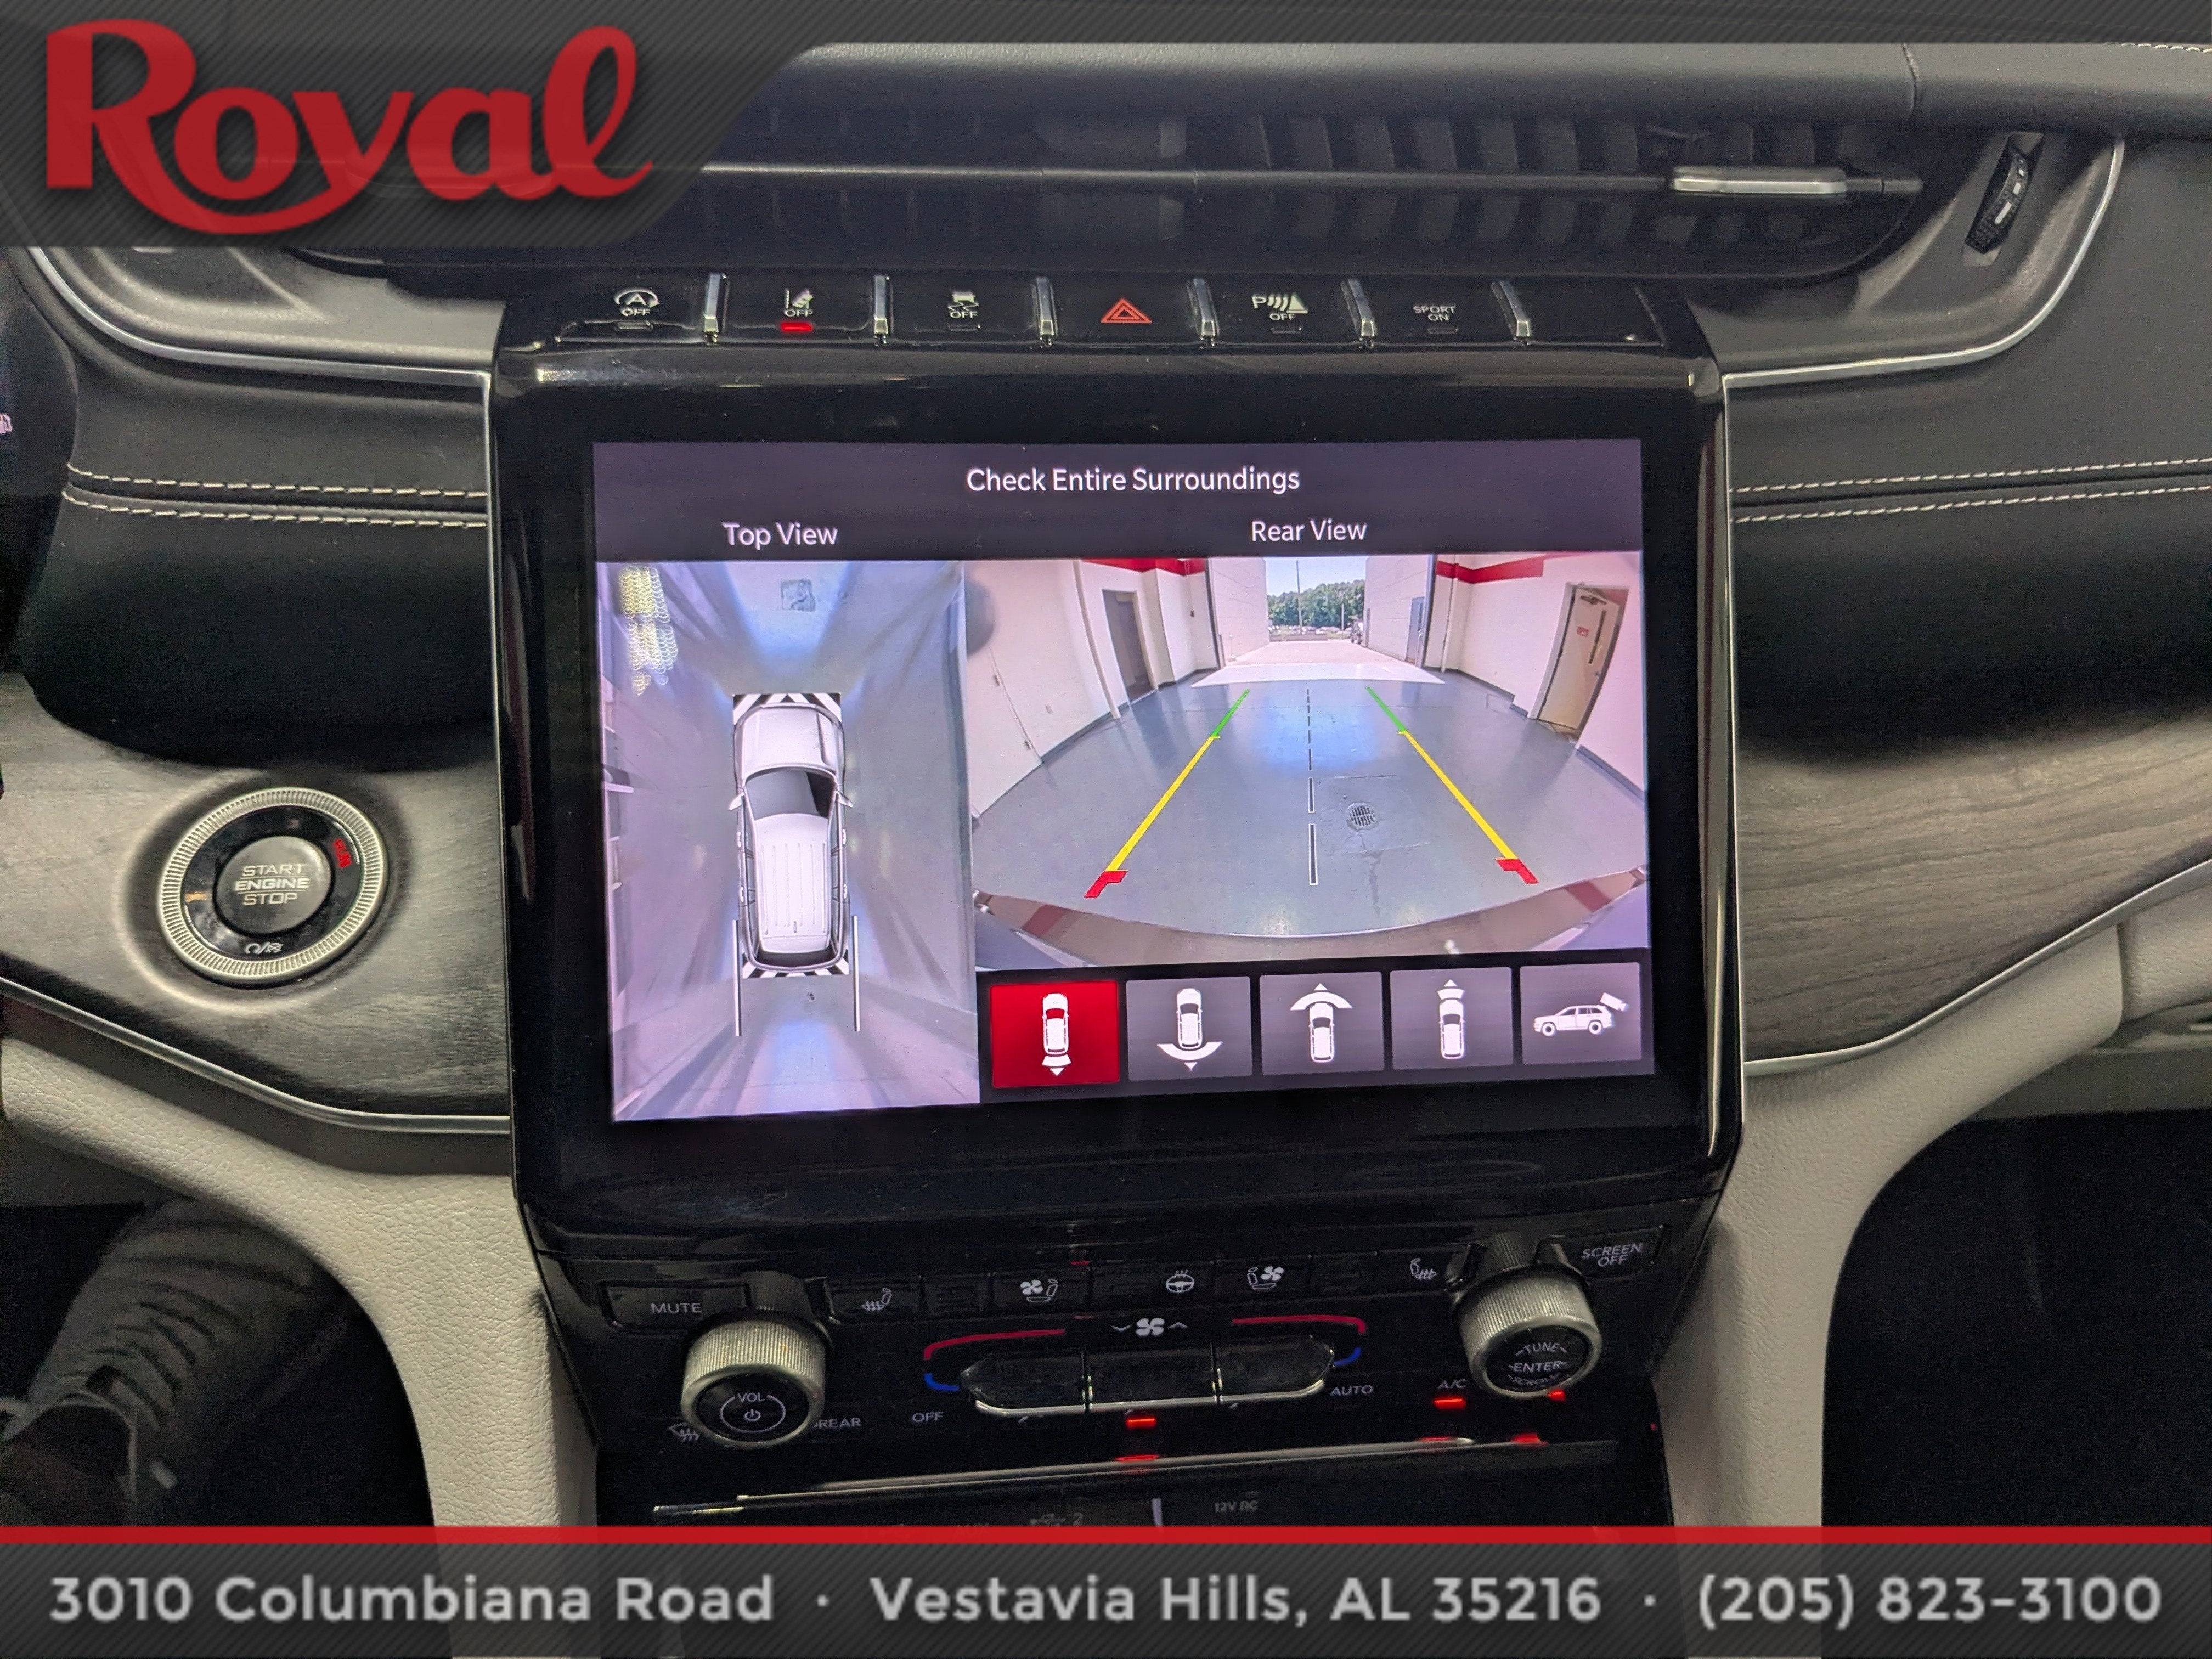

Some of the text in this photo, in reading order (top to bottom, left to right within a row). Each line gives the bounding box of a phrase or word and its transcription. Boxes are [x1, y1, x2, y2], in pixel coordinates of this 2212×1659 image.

[621, 308, 651, 317] OFF
[785, 309, 813, 317] OFF
[950, 311, 978, 319] OFF
[967, 466, 1300, 495] Check Entire Surroundings
[722, 522, 838, 550] Top View
[1252, 518, 1367, 542] Rear View
[242, 864, 307, 877] START
[235, 878, 310, 890] ENGINE
[242, 893, 297, 906] STOP
[1582, 1242, 1645, 1259] SCREEN
[1597, 1254, 1628, 1267] OFF
[651, 1302, 702, 1314] MUTE
[1522, 1342, 1560, 1354] TUNE
[1513, 1360, 1562, 1373] ENTER
[1330, 1384, 1374, 1396] AUTO
[1437, 1379, 1467, 1390] A/C
[737, 1392, 765, 1403] VOL
[818, 1418, 861, 1429] REAR
[911, 1412, 944, 1423] OFF
[1215, 1500, 1259, 1513] 12V DC
